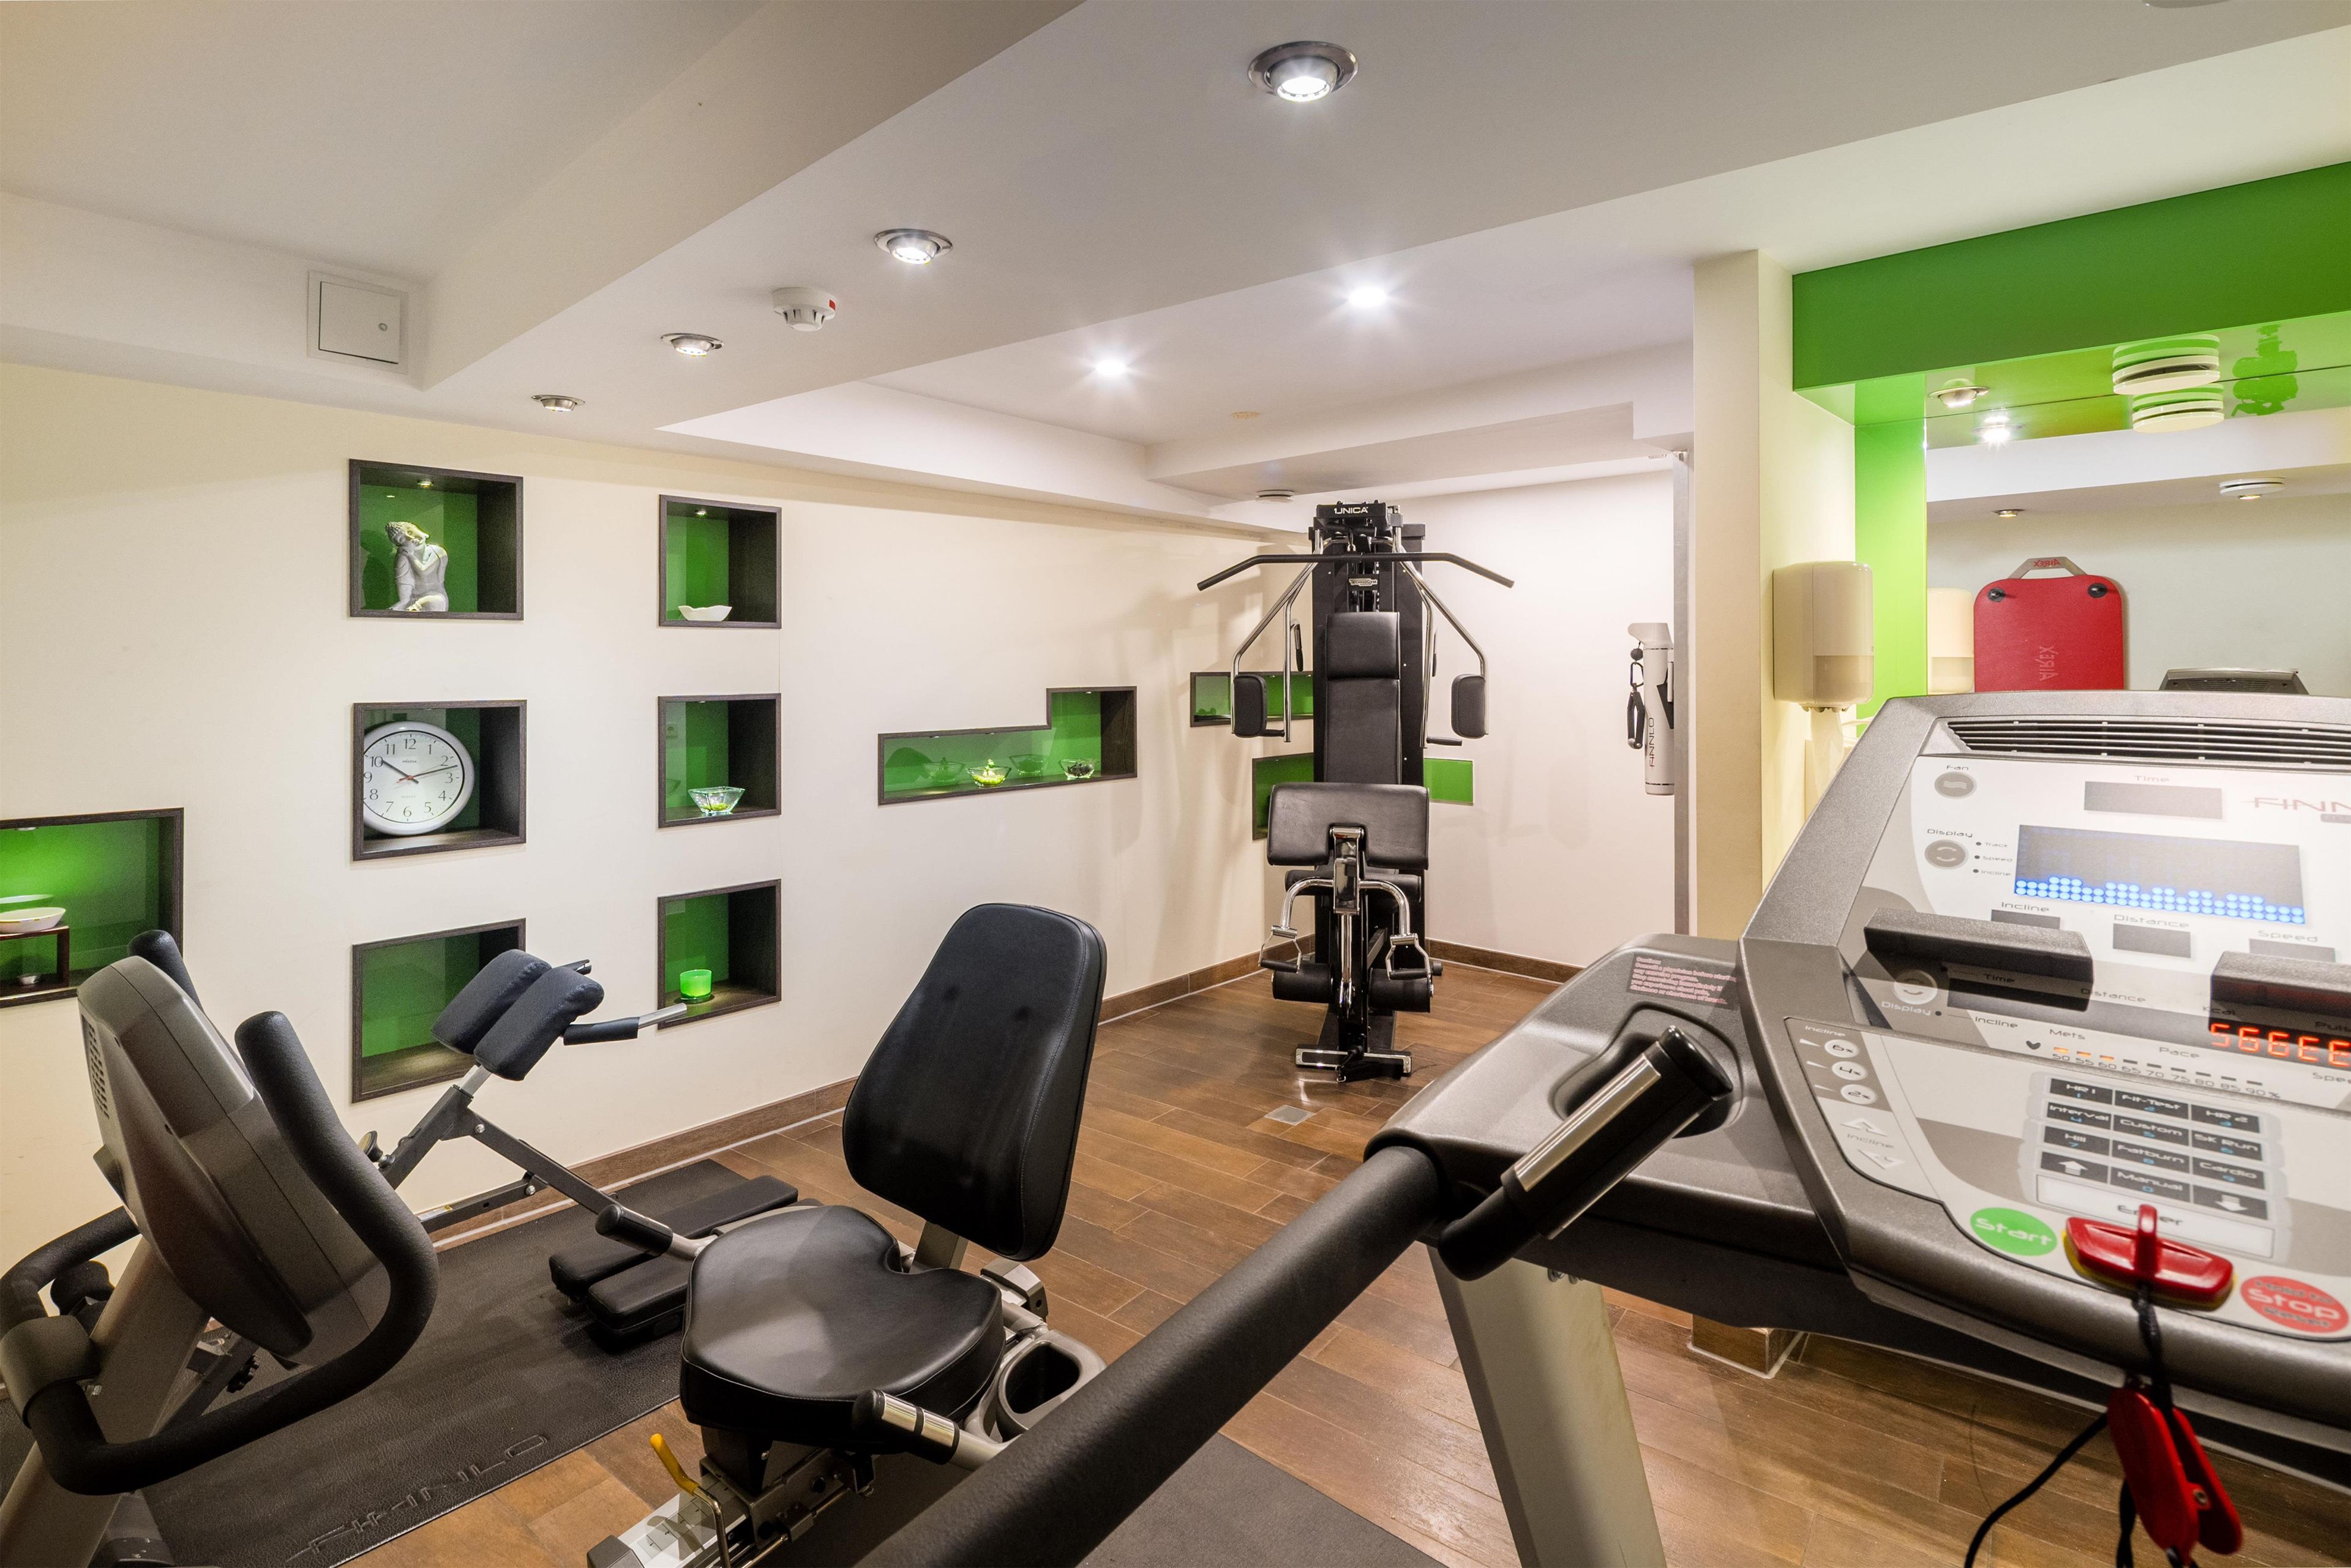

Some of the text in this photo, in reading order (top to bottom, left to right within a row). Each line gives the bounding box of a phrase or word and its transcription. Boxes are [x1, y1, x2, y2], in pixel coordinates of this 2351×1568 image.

[385, 744, 395, 755] 11
[404, 738, 416, 749] 12
[427, 744, 432, 755] 1
[369, 756, 383, 768] 10
[440, 756, 448, 766] 2
[364, 771, 372, 784] 9
[446, 772, 454, 784] 3
[369, 789, 378, 800] 8
[438, 790, 446, 801] 4
[386, 801, 394, 812] 7
[403, 806, 412, 817] 6
[424, 802, 432, 813] 5
[1927, 828, 1973, 838] Display
[2001, 901, 2050, 913] Incline
[2114, 913, 2190, 929] Distance
[2258, 929, 2318, 944] Speed
[1984, 973, 2015, 983] Time
[2081, 988, 2147, 1003] Dstance
[1881, 1001, 1931, 1016] Display
[1974, 1016, 2018, 1029] Incline
[1805, 1025, 1846, 1037] Incline
[2049, 1029, 2085, 1040] Mets
[2159, 1046, 2200, 1059] Pace
[2052, 1053, 2070, 1062] 50
[2075, 1057, 2094, 1066] 55
[2098, 1062, 2117, 1070] 60
[2121, 1066, 2141, 1075] 65
[2170, 1075, 2191, 1084] 75
[2195, 1079, 2214, 1087] 80
[2221, 1084, 2241, 1092] 85
[2066, 1084, 2089, 1092] HR
[2121, 1094, 2181, 1110] Fit-Test
[2049, 1105, 2110, 1121] Interval
[2205, 1110, 2232, 1119] HR
[2120, 1119, 2183, 1136] Custom
[1847, 1133, 1894, 1149] Incline
[2064, 1133, 2087, 1142] Hill
[2221, 1139, 2259, 1152] Run
[2117, 1144, 2184, 1164] Fatburn
[2200, 1162, 2258, 1179] Cardio
[2117, 1171, 2183, 1191] Manual
[2118, 1204, 2184, 1225] Eer
[1976, 1217, 2053, 1245] Start
[2248, 1288, 2341, 1320] Stop
